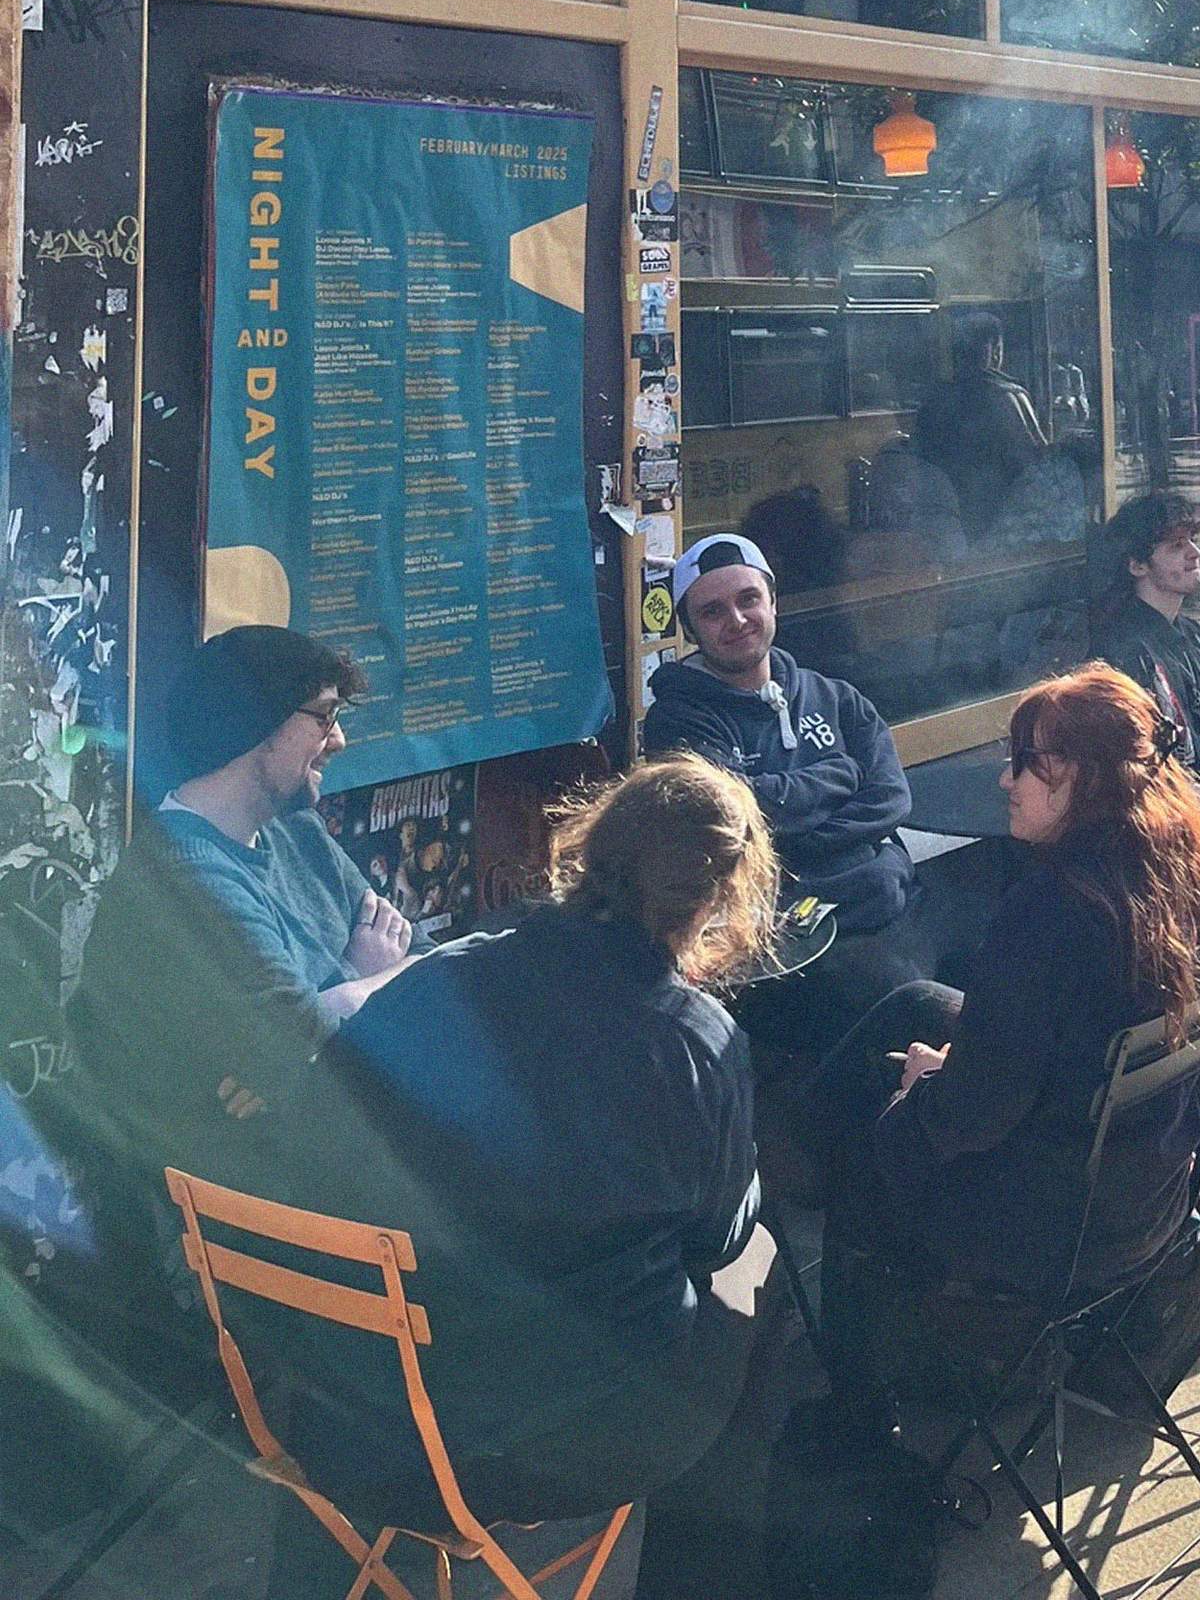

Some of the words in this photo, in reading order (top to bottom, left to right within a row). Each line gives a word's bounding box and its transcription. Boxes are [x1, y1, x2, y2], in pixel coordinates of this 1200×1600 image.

[420, 138, 529, 160] FEBRUARY/MARCH
[536, 145, 568, 162] 2025
[505, 163, 568, 180] LISTINGS
[249, 126, 285, 312] NIGHT
[237, 329, 289, 348] AND
[244, 366, 277, 480] DAY
[803, 723, 836, 751] 18
